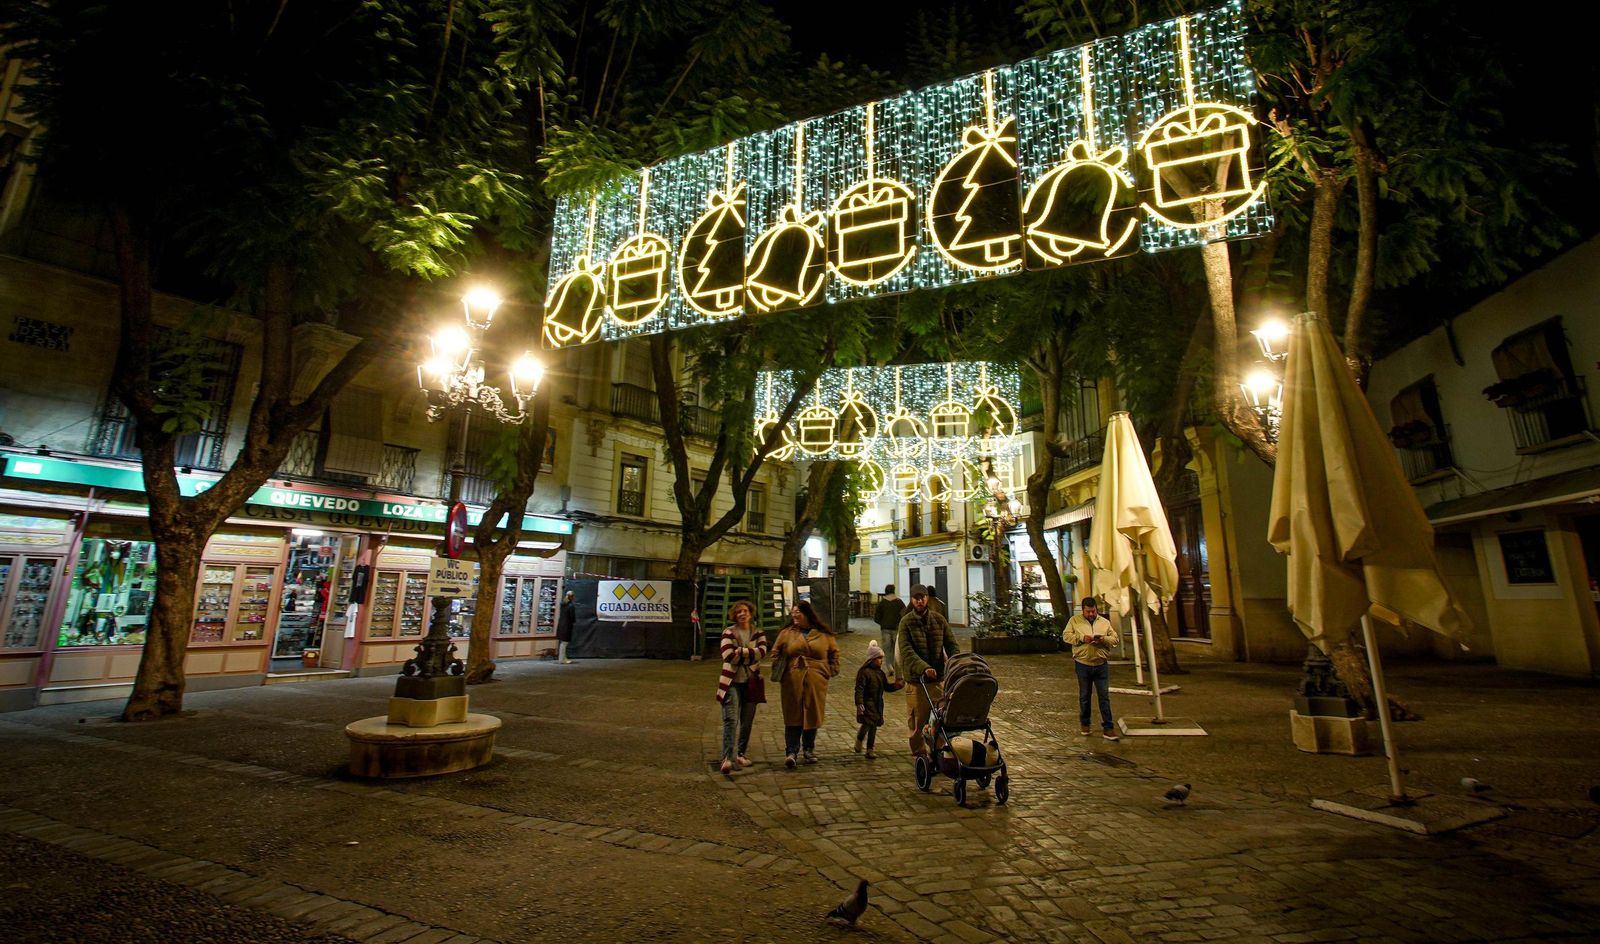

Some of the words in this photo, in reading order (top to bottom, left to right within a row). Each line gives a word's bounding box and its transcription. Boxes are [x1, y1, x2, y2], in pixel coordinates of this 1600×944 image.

[270, 491, 360, 512] QUEVEDO
[383, 503, 424, 518] LOZA
[245, 504, 313, 522] CASA
[328, 512, 429, 531] QUEVEDO
[436, 567, 468, 581] PÚBLICO
[447, 559, 460, 569] WC
